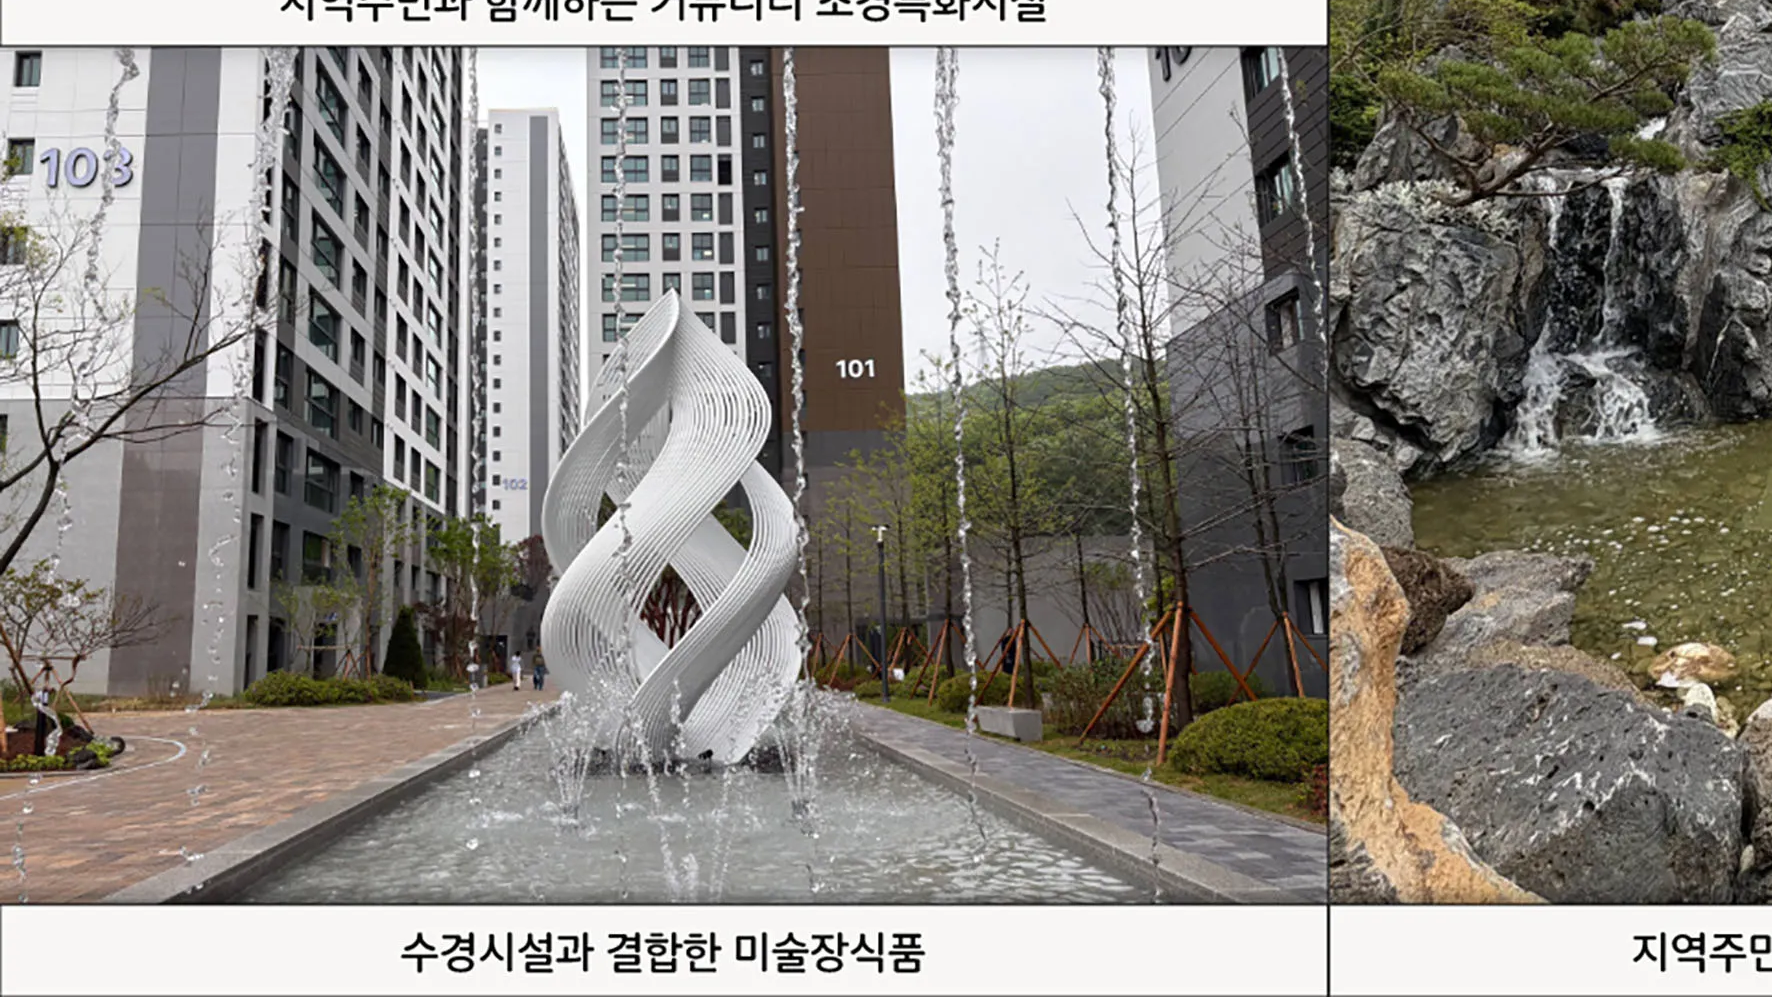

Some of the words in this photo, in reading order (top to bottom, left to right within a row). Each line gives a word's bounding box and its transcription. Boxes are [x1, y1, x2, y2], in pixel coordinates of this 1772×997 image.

[40, 147, 133, 188] 103
[835, 359, 875, 378] 101
[503, 478, 528, 491] 102
